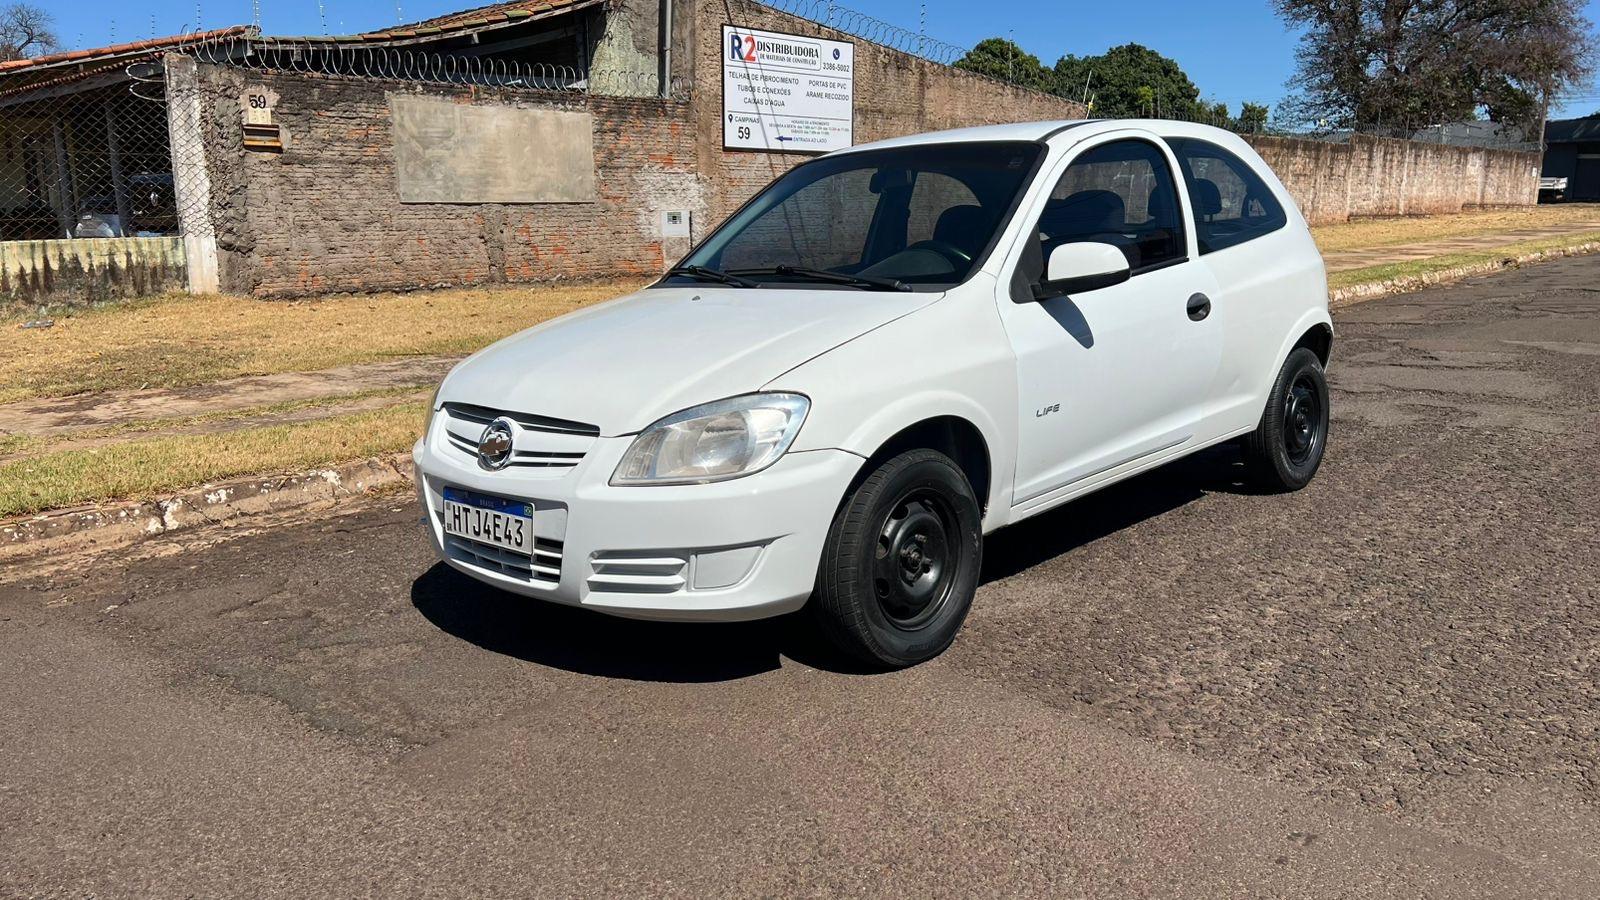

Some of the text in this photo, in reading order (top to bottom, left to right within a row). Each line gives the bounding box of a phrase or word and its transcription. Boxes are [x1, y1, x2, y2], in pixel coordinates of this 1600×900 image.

[730, 34, 818, 62] R2 DISTRIBUIDORA
[792, 57, 816, 66] CONSTRUÇÃO
[729, 71, 750, 80] TELHAS
[760, 74, 800, 85] FIBROCIMENTO
[738, 84, 756, 92] TUBOS
[762, 86, 791, 96] CONEXÕES
[824, 92, 850, 101] RECOZIDO
[248, 94, 266, 109] 59
[744, 97, 764, 106] CAIXAS
[738, 126, 750, 140] 59
[1036, 404, 1060, 418] LIFE
[452, 505, 524, 547] HTJ4E43
